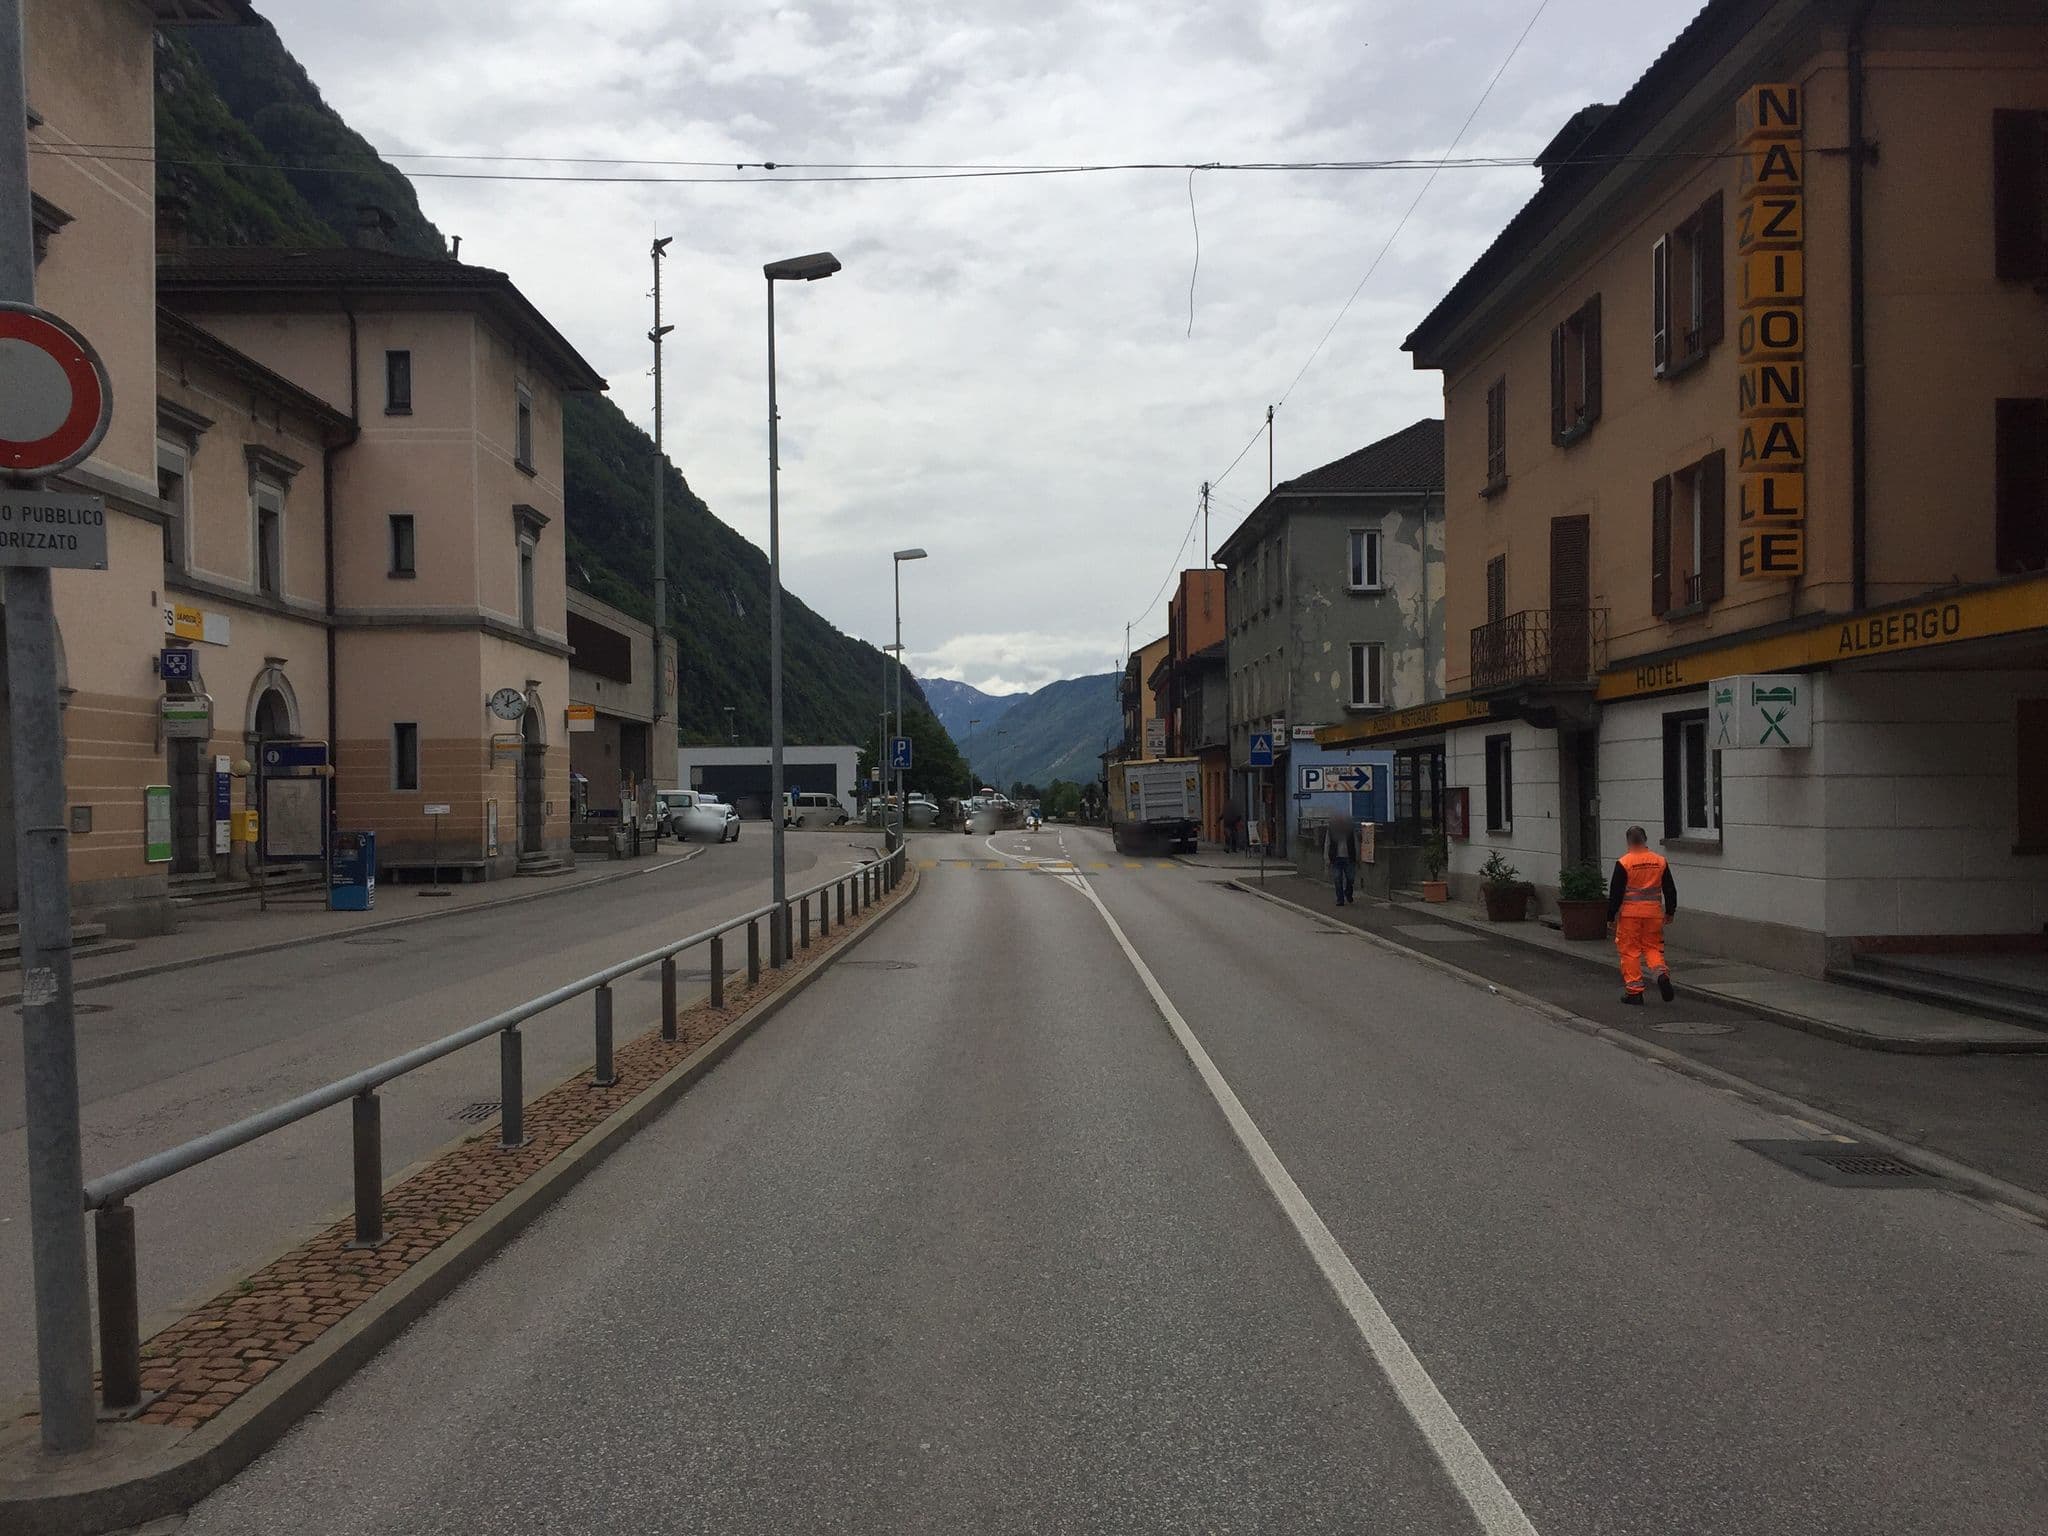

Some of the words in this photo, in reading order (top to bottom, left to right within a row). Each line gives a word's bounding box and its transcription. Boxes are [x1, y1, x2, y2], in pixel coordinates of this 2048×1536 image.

[1759, 88, 1801, 572] NAZIONALE
[22, 506, 103, 526] PUBBLICO
[0, 531, 77, 550] ORIZZATO
[1838, 604, 1960, 654] ALBERGO
[1636, 661, 1683, 689] HOTEL
[1305, 769, 1320, 788] P
